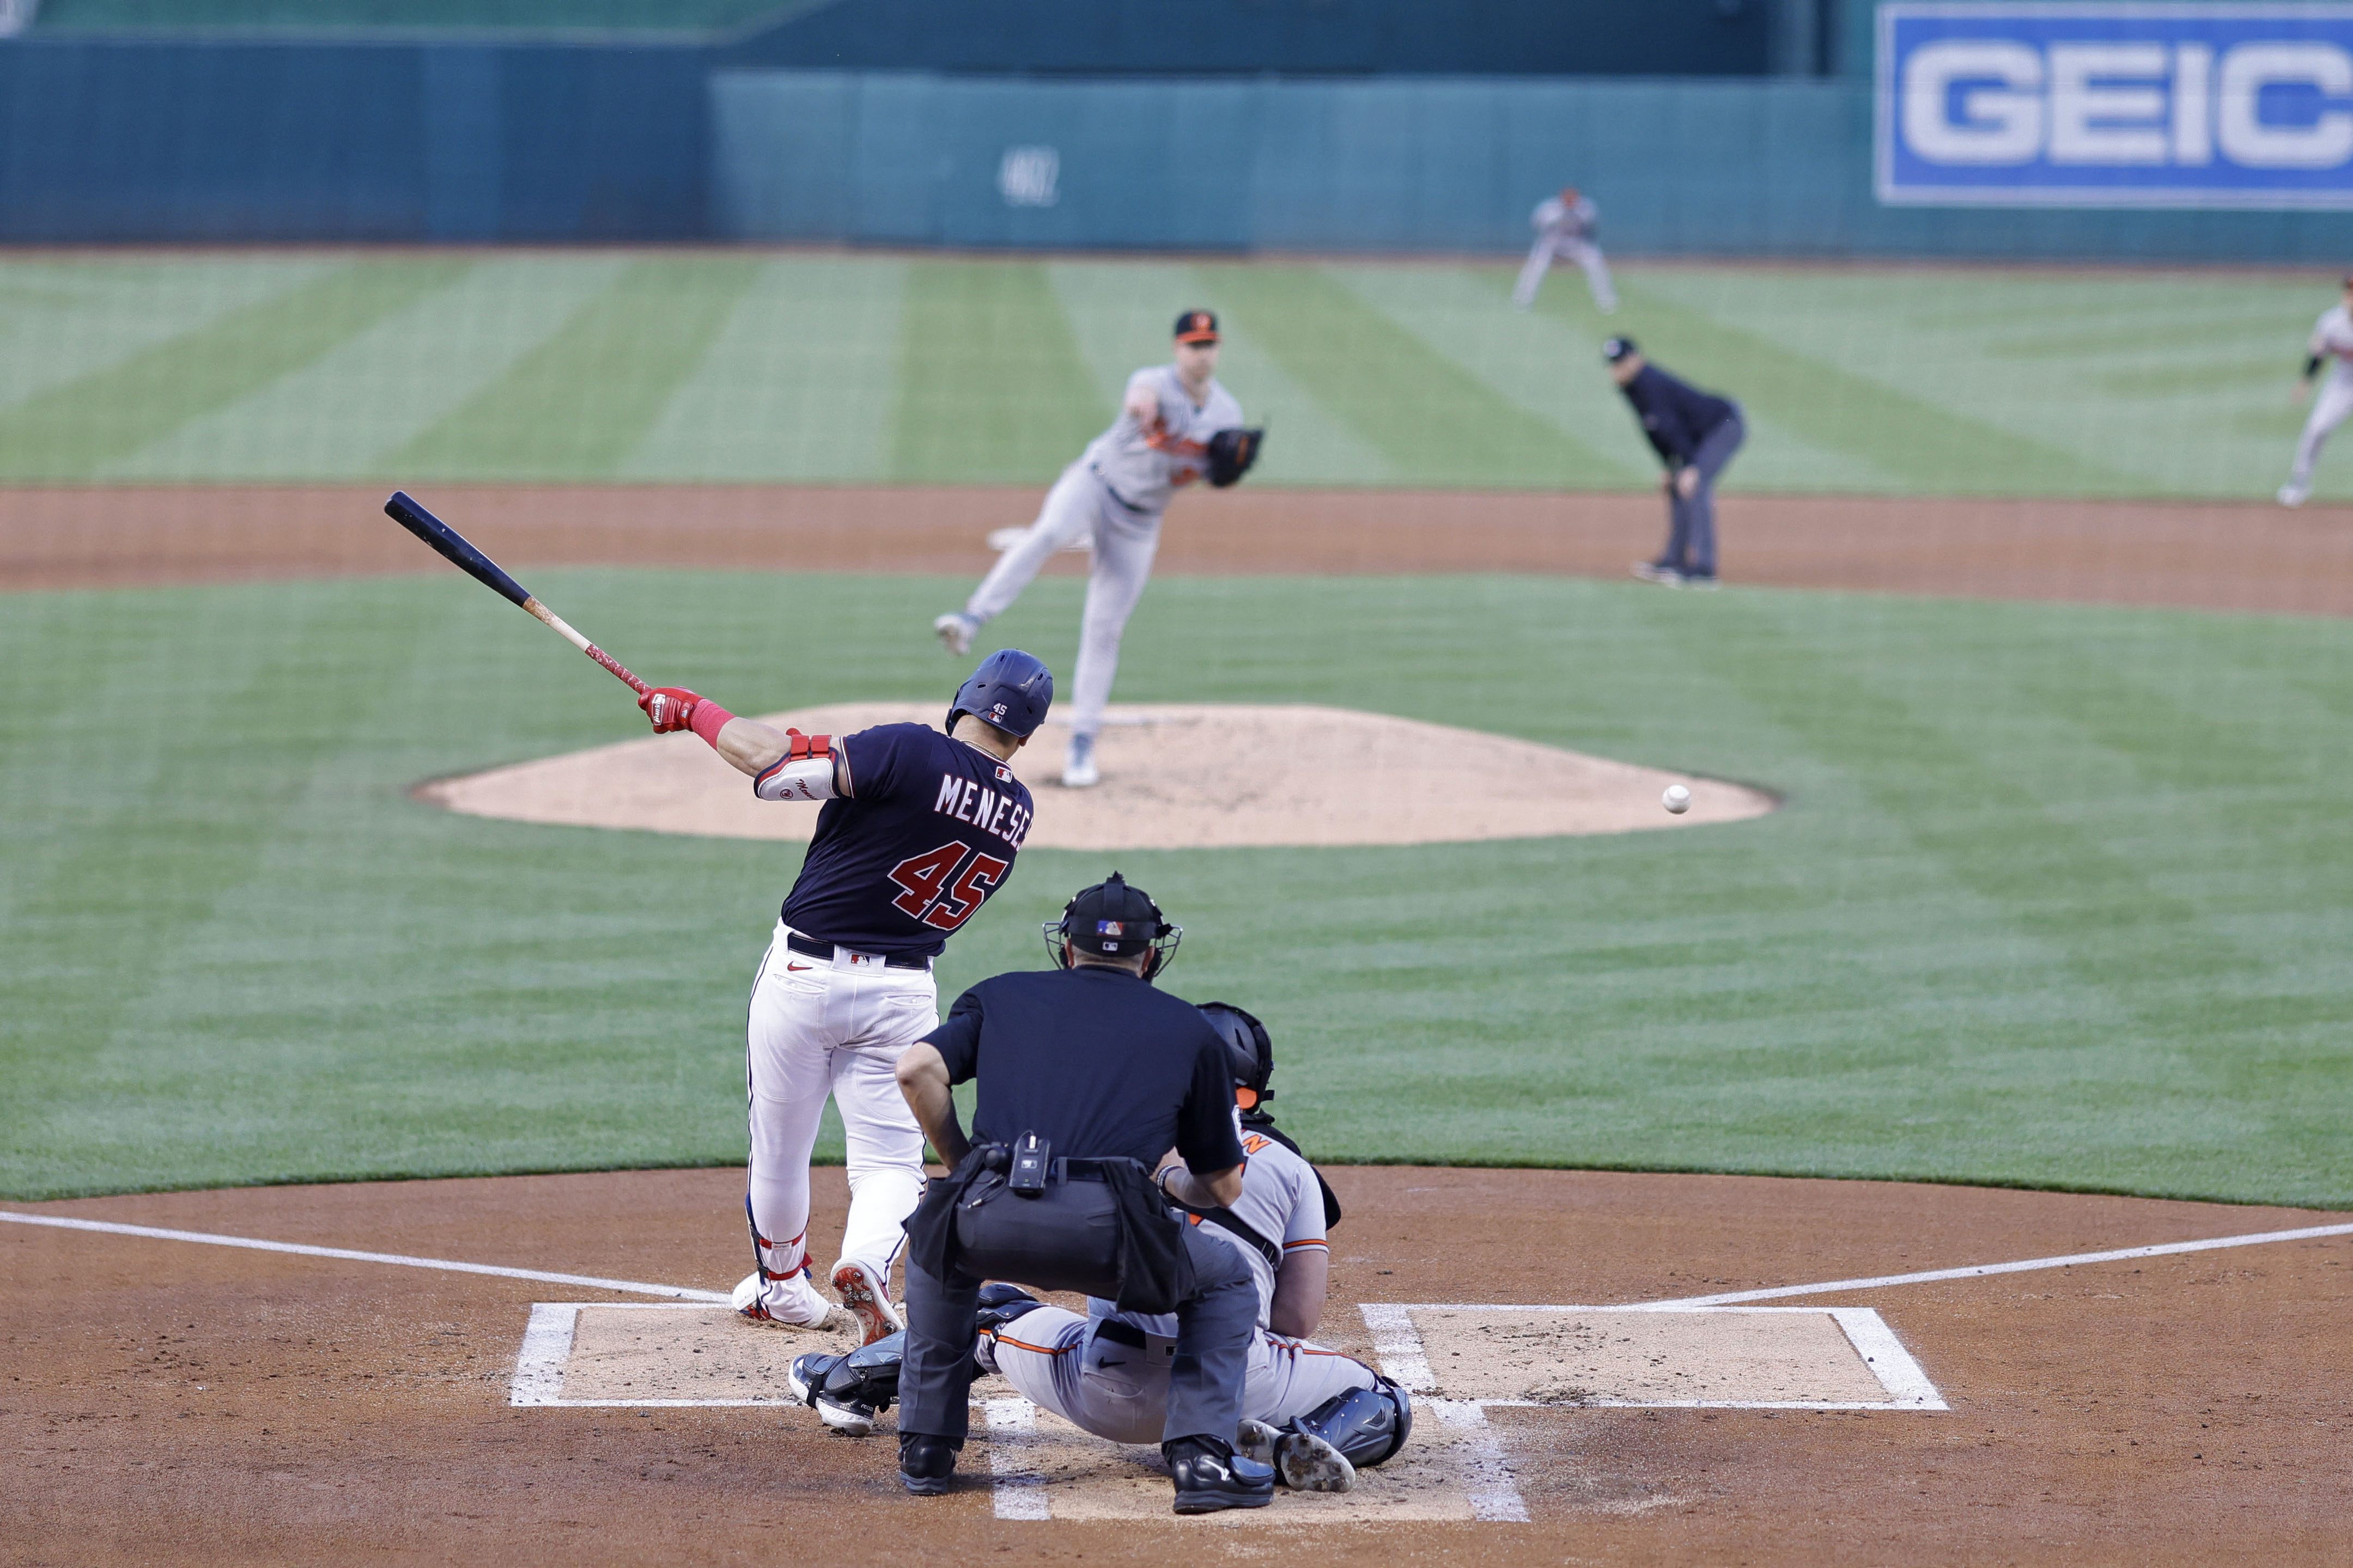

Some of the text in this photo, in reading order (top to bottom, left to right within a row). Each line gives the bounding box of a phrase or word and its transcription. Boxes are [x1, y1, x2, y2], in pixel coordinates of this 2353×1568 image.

[1901, 39, 2353, 168] GEIC
[993, 703, 1007, 716] 45
[933, 773, 1033, 852] MENESE
[887, 840, 1009, 931] 45
